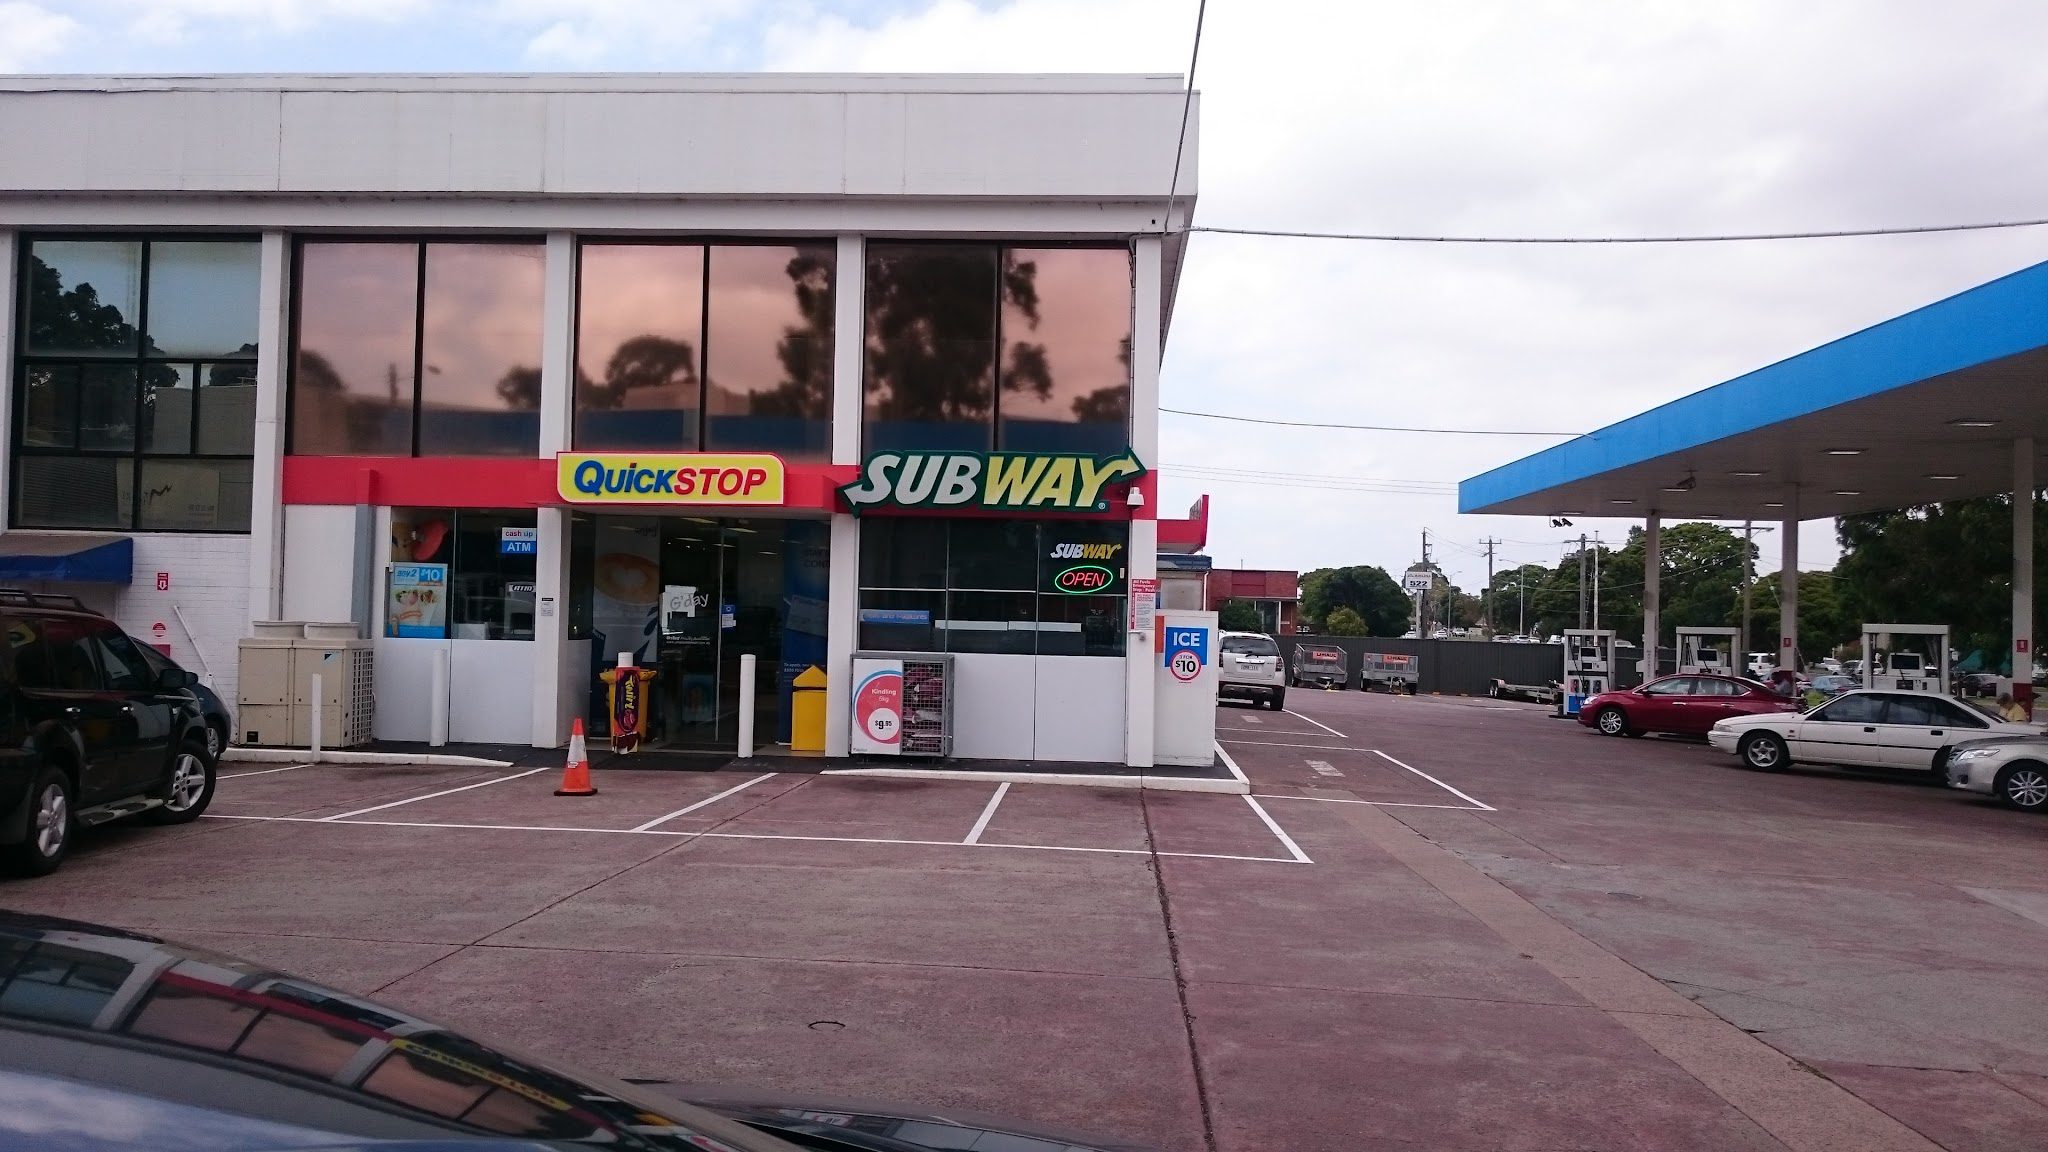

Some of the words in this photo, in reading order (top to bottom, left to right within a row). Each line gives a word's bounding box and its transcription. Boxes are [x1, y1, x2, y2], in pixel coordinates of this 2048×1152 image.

[844, 453, 1140, 508] SUBWAY
[507, 542, 531, 552] ATM
[1050, 543, 1122, 559] SUBWAY
[421, 568, 440, 581] $10
[1062, 572, 1106, 586] OPEN
[670, 594, 709, 610] G'day
[1173, 632, 1200, 647] ICE
[1175, 660, 1196, 673] $10
[871, 688, 897, 696] Kindling
